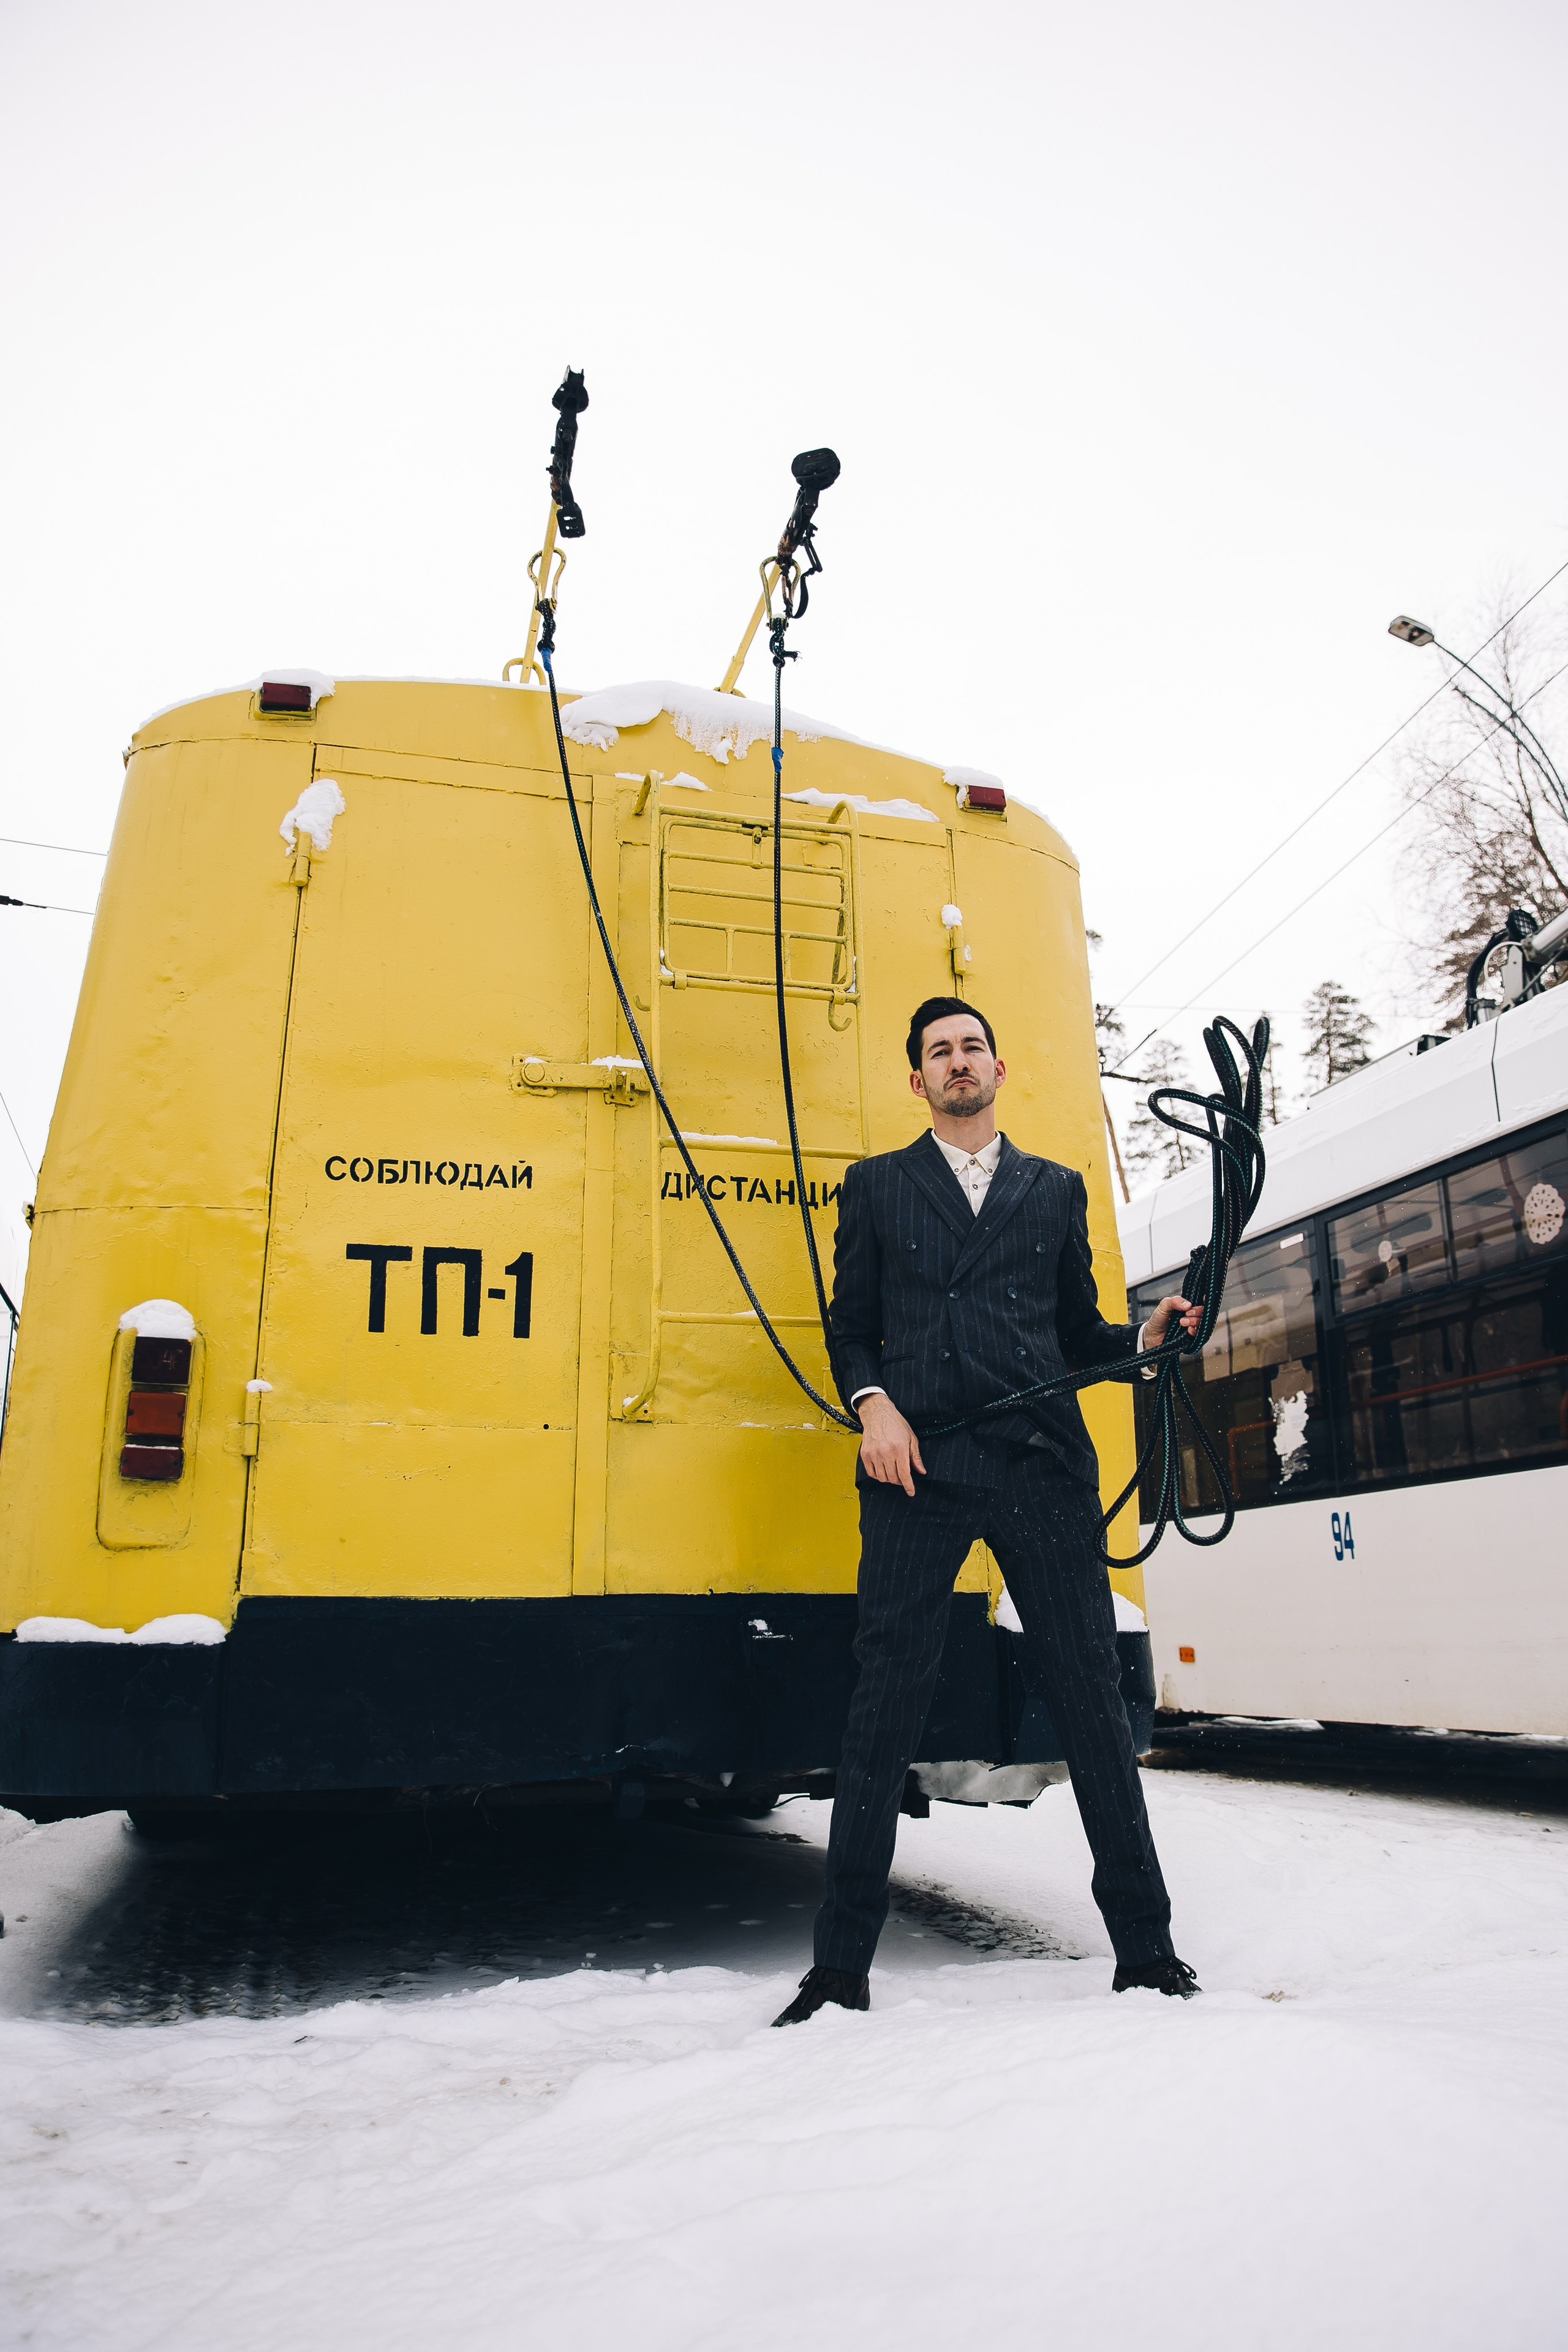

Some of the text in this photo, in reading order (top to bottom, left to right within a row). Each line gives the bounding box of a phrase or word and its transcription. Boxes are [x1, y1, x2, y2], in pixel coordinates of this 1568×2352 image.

[325, 1155, 533, 1191] СОБЛЮДАЙ
[345, 1243, 534, 1339] ТП-1
[1331, 1511, 1355, 1561] 94
